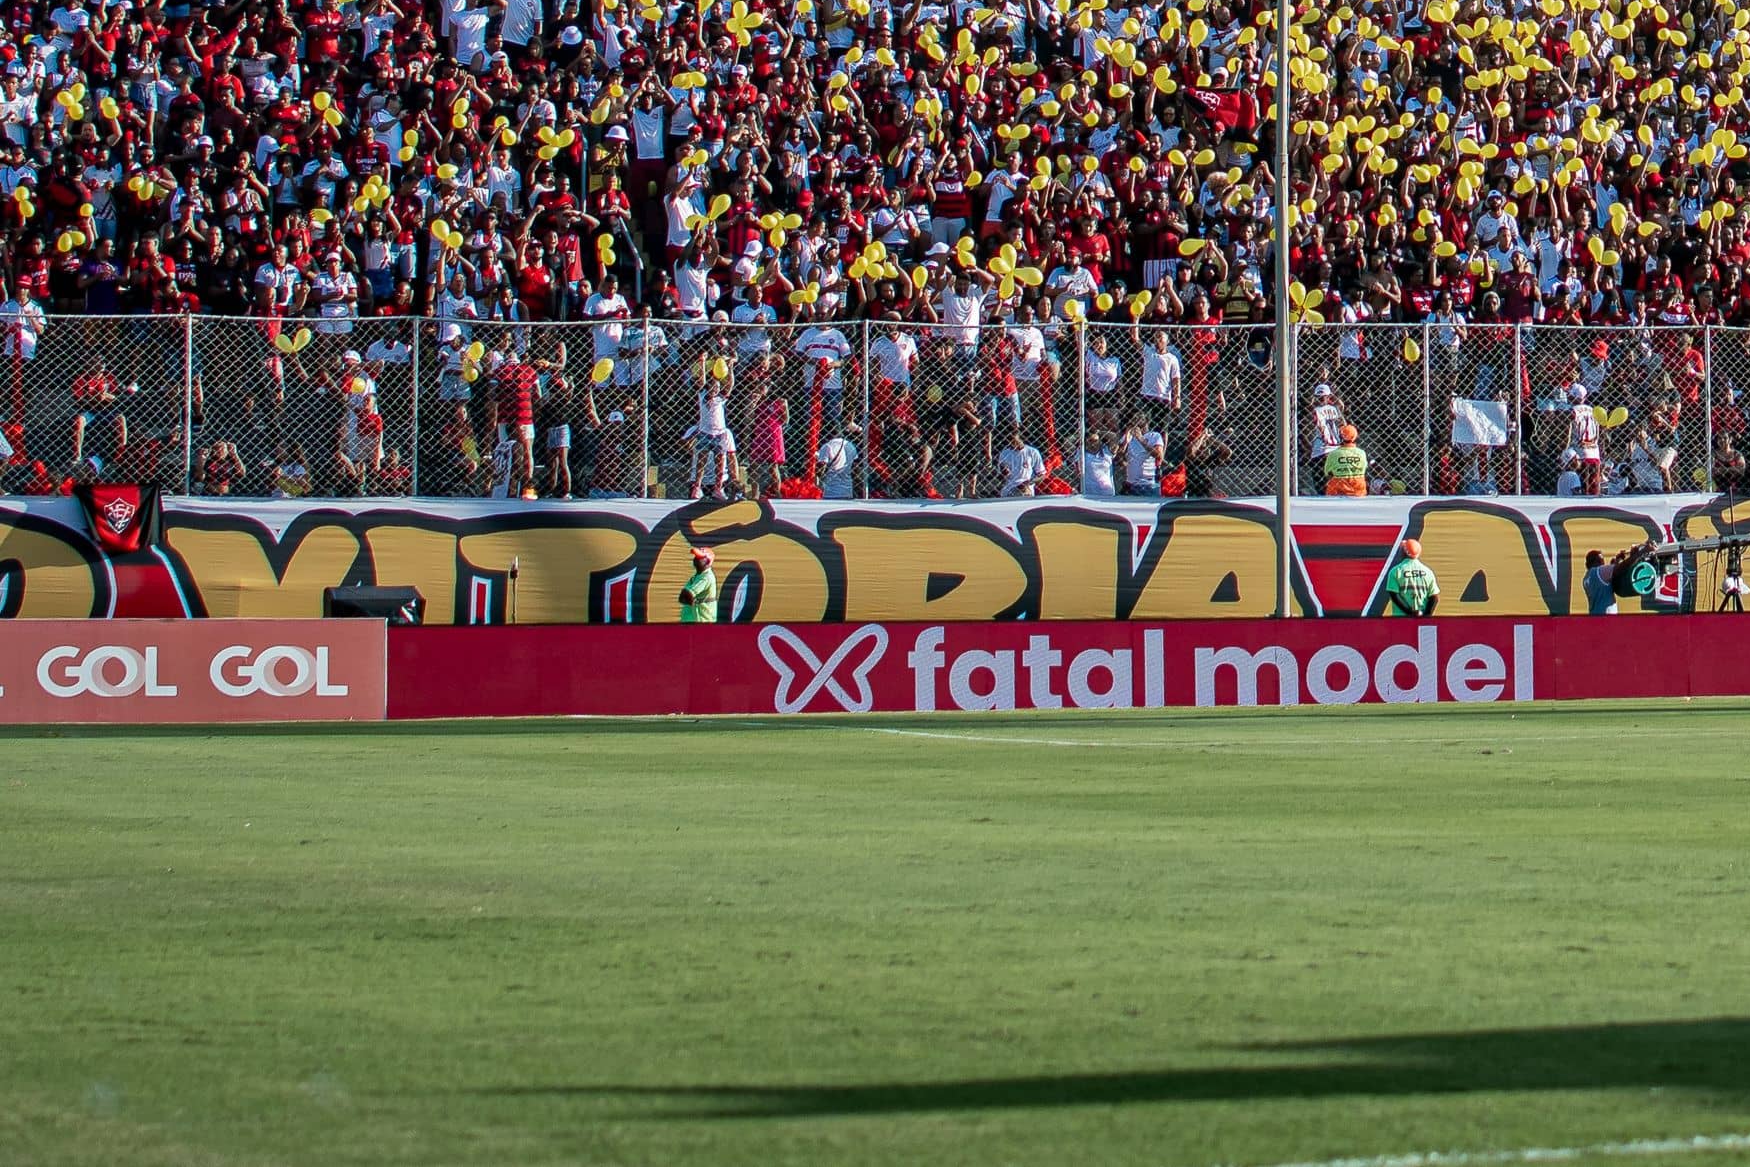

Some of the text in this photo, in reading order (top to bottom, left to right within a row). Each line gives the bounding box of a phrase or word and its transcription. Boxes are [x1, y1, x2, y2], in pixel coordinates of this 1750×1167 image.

[36, 644, 349, 698] GOL GOL
[908, 623, 1534, 713] fatal model
